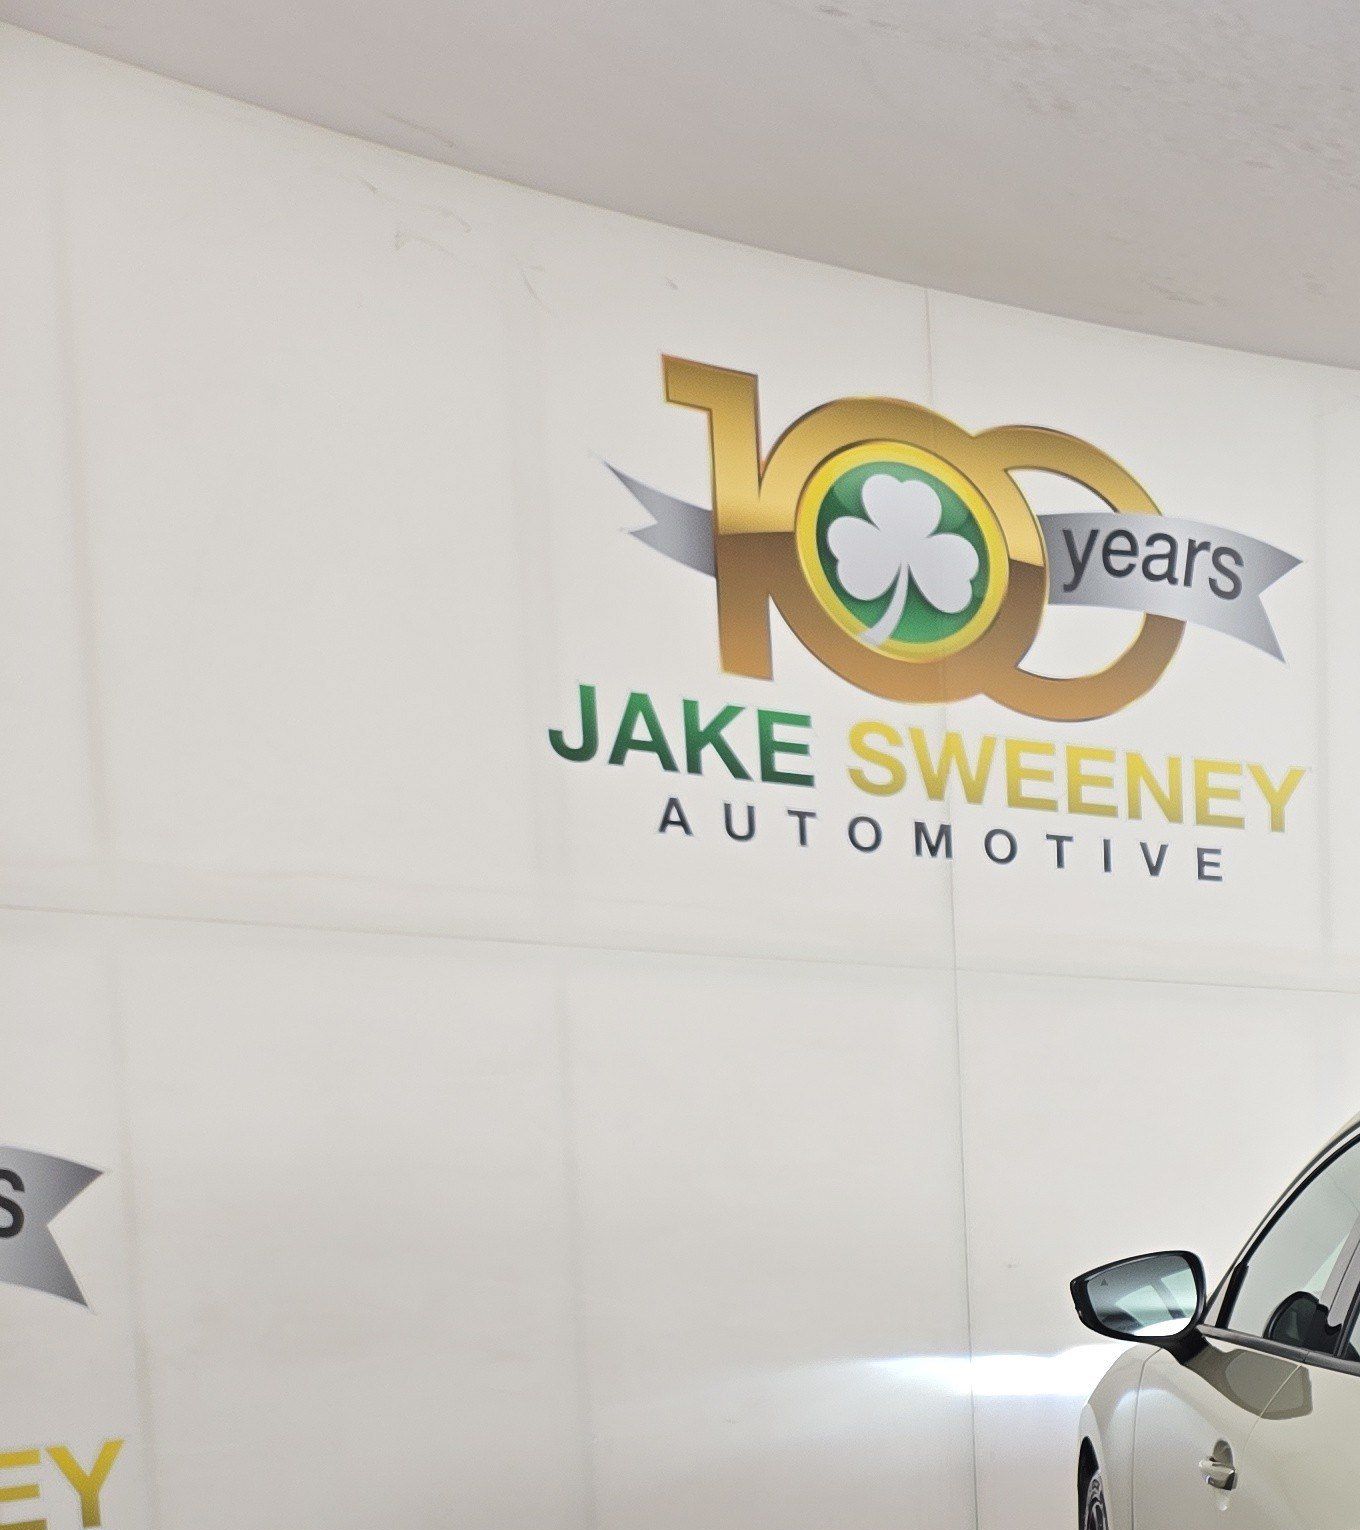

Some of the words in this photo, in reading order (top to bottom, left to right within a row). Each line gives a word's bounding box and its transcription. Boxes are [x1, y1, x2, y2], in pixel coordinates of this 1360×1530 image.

[661, 353, 1187, 722] 100
[1060, 524, 1245, 601] years
[547, 682, 816, 789] JAKE
[846, 719, 1308, 833] SWEENEY
[657, 797, 1225, 882] AUTOMOTIVE
